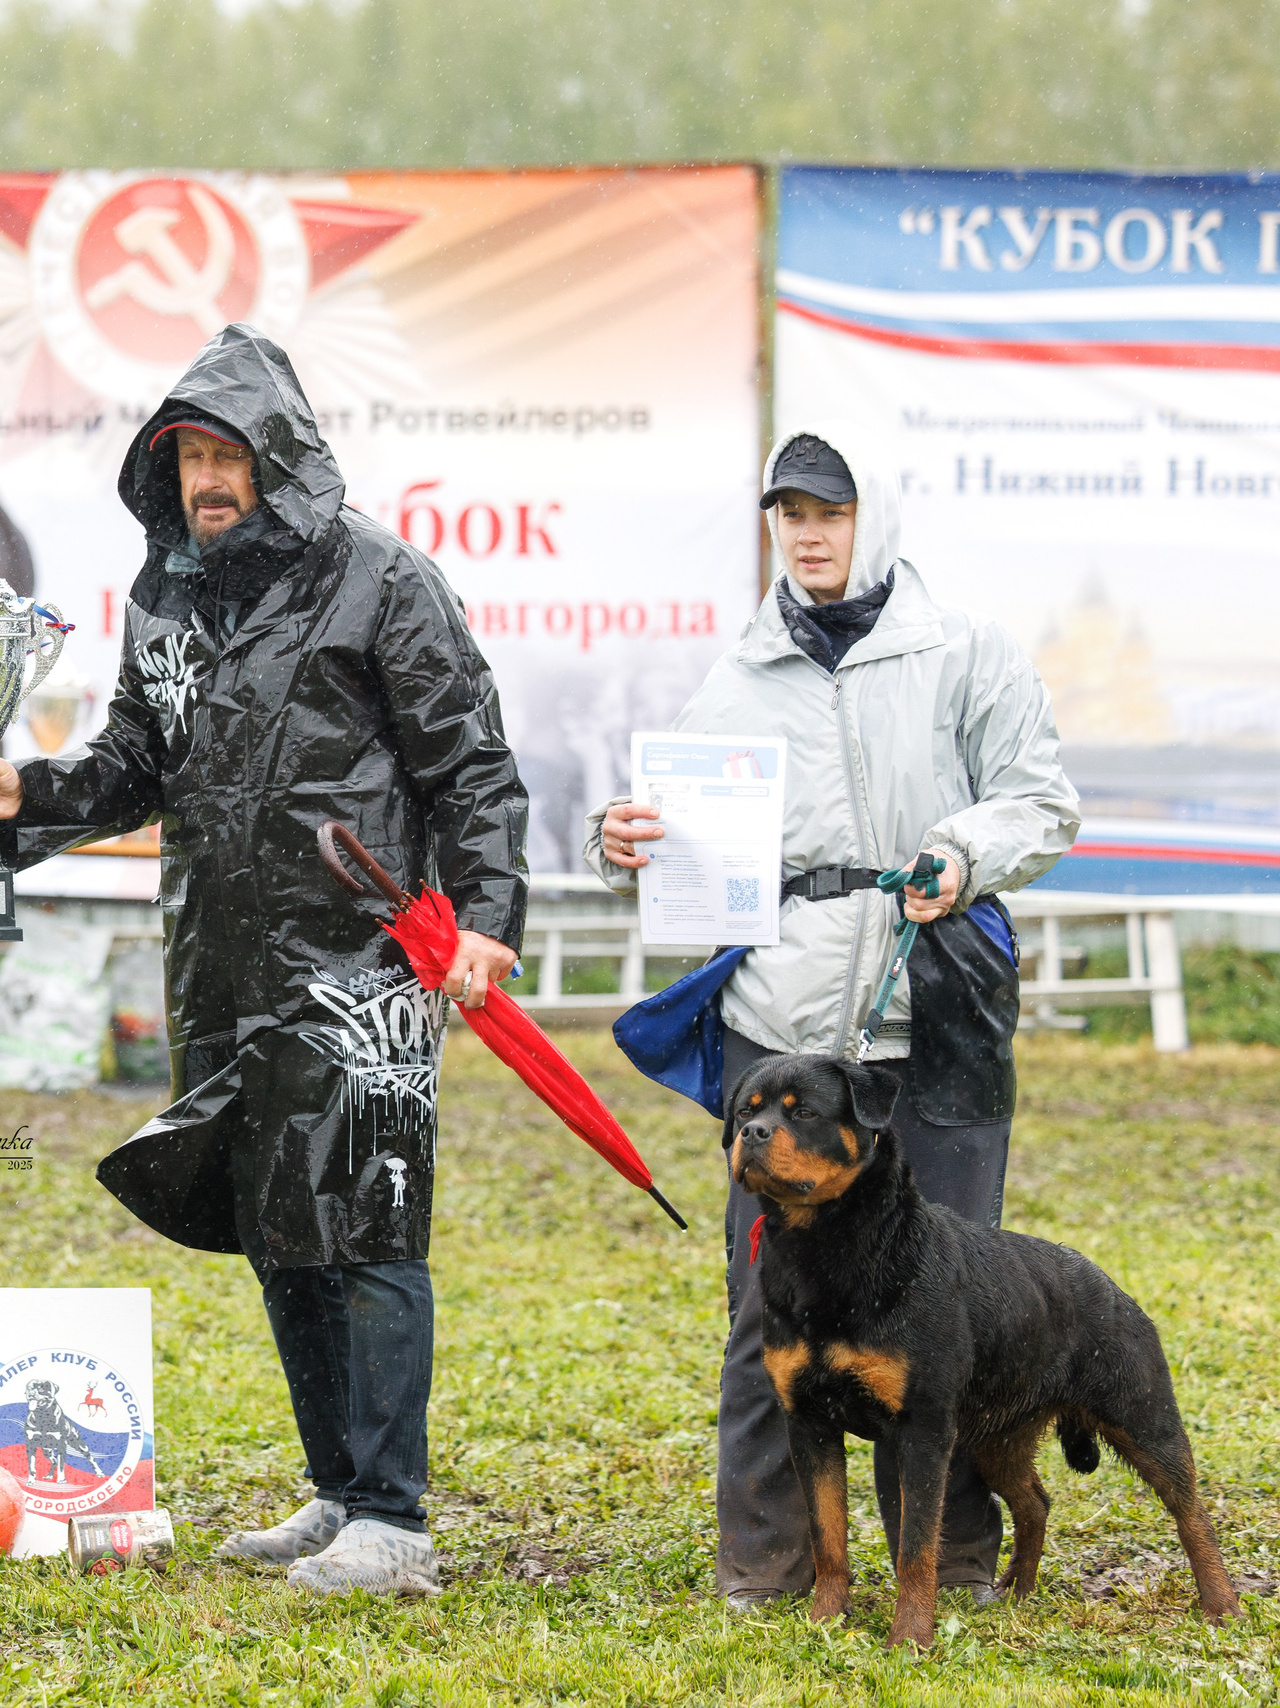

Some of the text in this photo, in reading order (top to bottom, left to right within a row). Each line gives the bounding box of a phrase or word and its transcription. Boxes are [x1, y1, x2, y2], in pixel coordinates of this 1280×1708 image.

[368, 402, 652, 441] Ротвейлеров
[954, 453, 1144, 497] Нижний
[1164, 453, 1280, 497] Новг
[347, 477, 566, 560] бок
[466, 596, 716, 653] вгорода
[51, 1352, 98, 1371] КЛУБ
[105, 1371, 141, 1441] РОССИИ
[25, 1466, 132, 1513] ГОРОДСКОЕ РО
